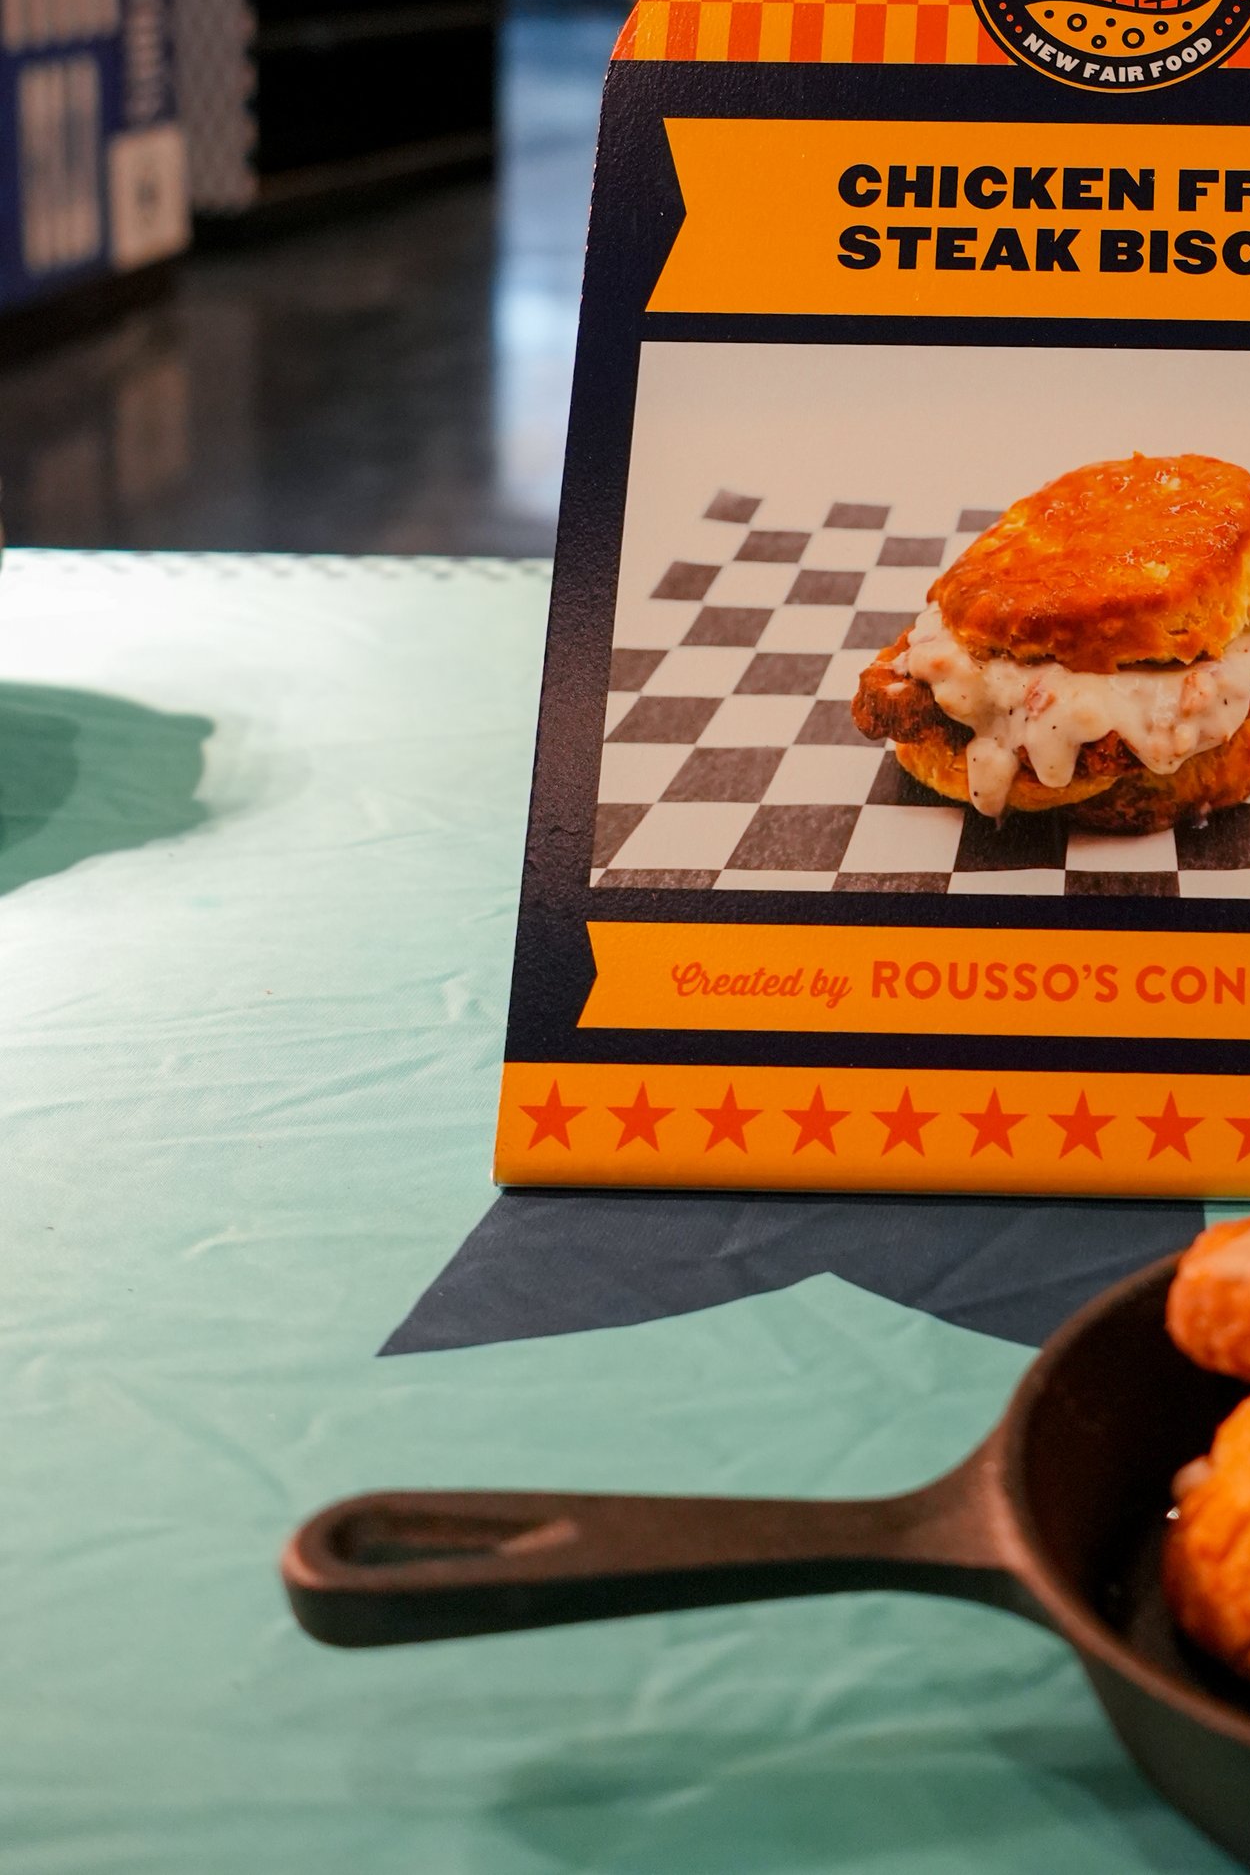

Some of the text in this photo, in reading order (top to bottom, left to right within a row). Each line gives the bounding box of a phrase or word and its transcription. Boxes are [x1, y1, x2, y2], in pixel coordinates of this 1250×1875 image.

[1022, 33, 1213, 83] NEW FAIR FOOD
[837, 163, 1156, 211] CHICKEN
[836, 224, 1081, 272] STEAK
[671, 963, 804, 999] Created
[809, 967, 852, 1010] by
[871, 960, 1120, 1005] ROUSSO'S
